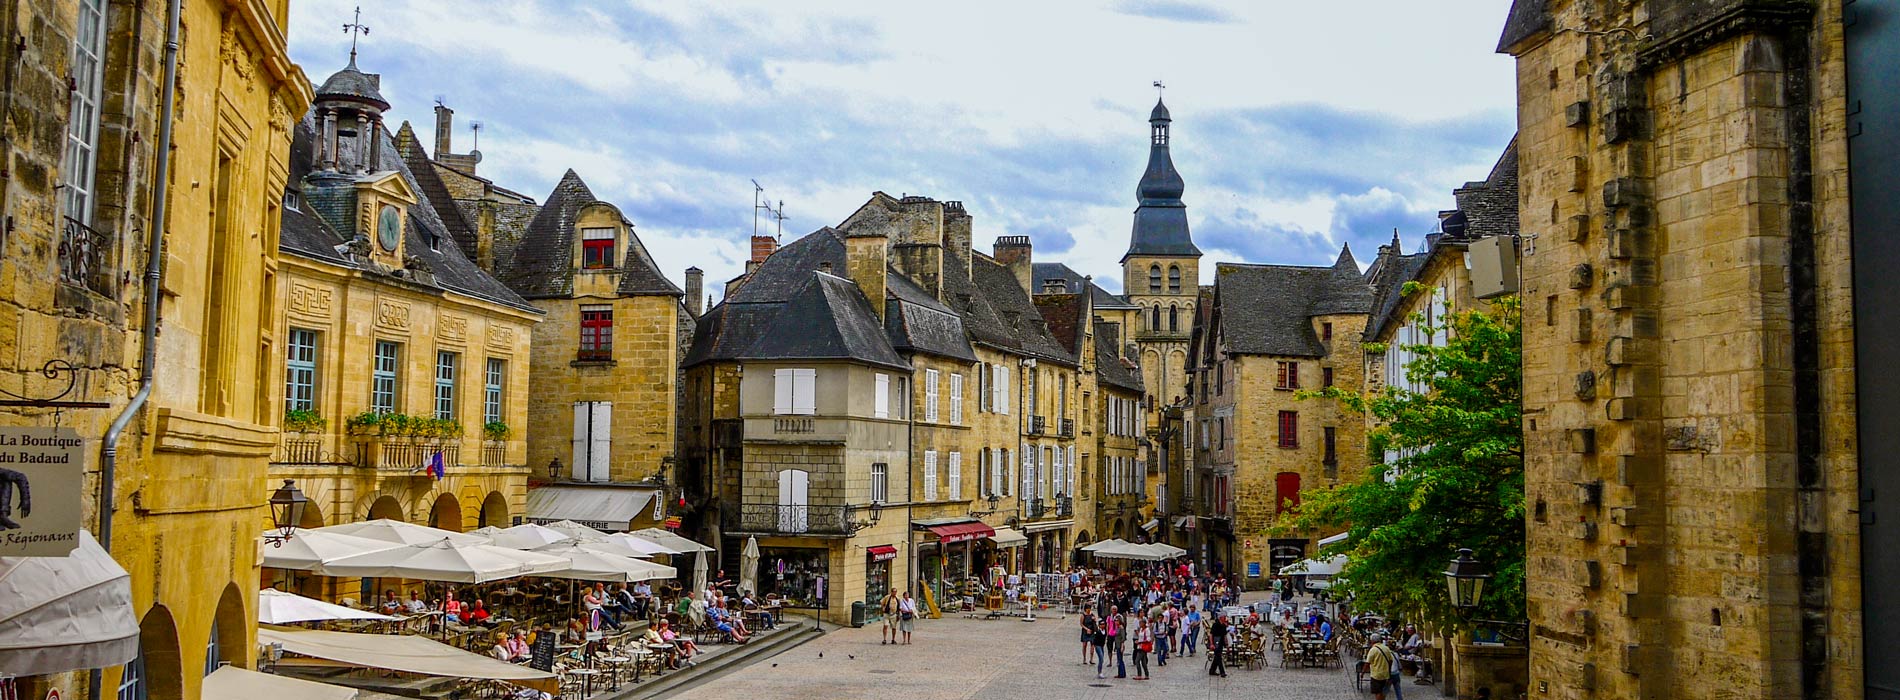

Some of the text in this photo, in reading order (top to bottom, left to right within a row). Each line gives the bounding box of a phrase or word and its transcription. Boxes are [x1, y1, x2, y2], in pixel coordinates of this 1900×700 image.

[0, 434, 81, 450] La Boutique
[0, 452, 70, 464] du Badaud
[5, 531, 75, 550] Régionaux
